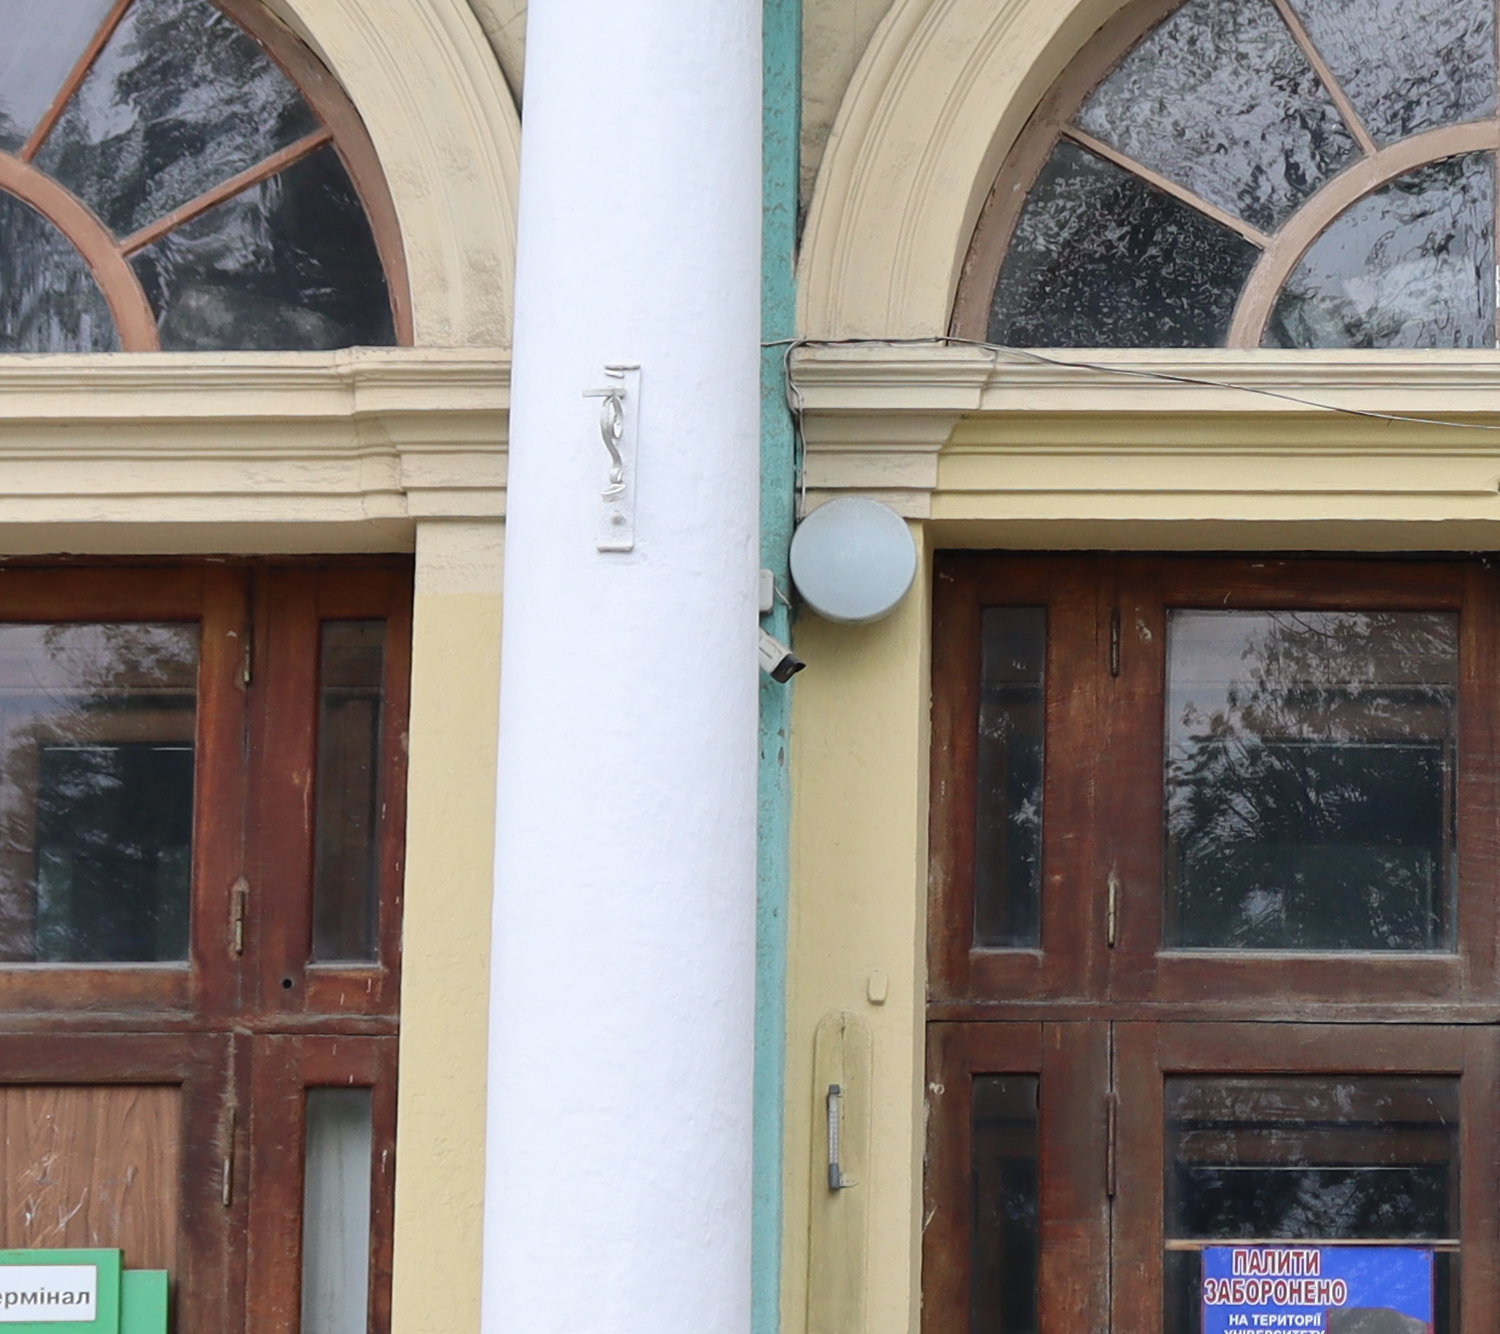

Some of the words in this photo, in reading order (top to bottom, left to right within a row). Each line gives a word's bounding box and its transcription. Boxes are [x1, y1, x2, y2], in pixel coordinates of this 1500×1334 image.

[1232, 1249, 1320, 1276] ПАЛИТИ
[1203, 1278, 1347, 1306] ЗАБОРОНЕНО
[1229, 1314, 1248, 1326] НА
[1252, 1313, 1321, 1327] ТЕРИТОРІЇ
